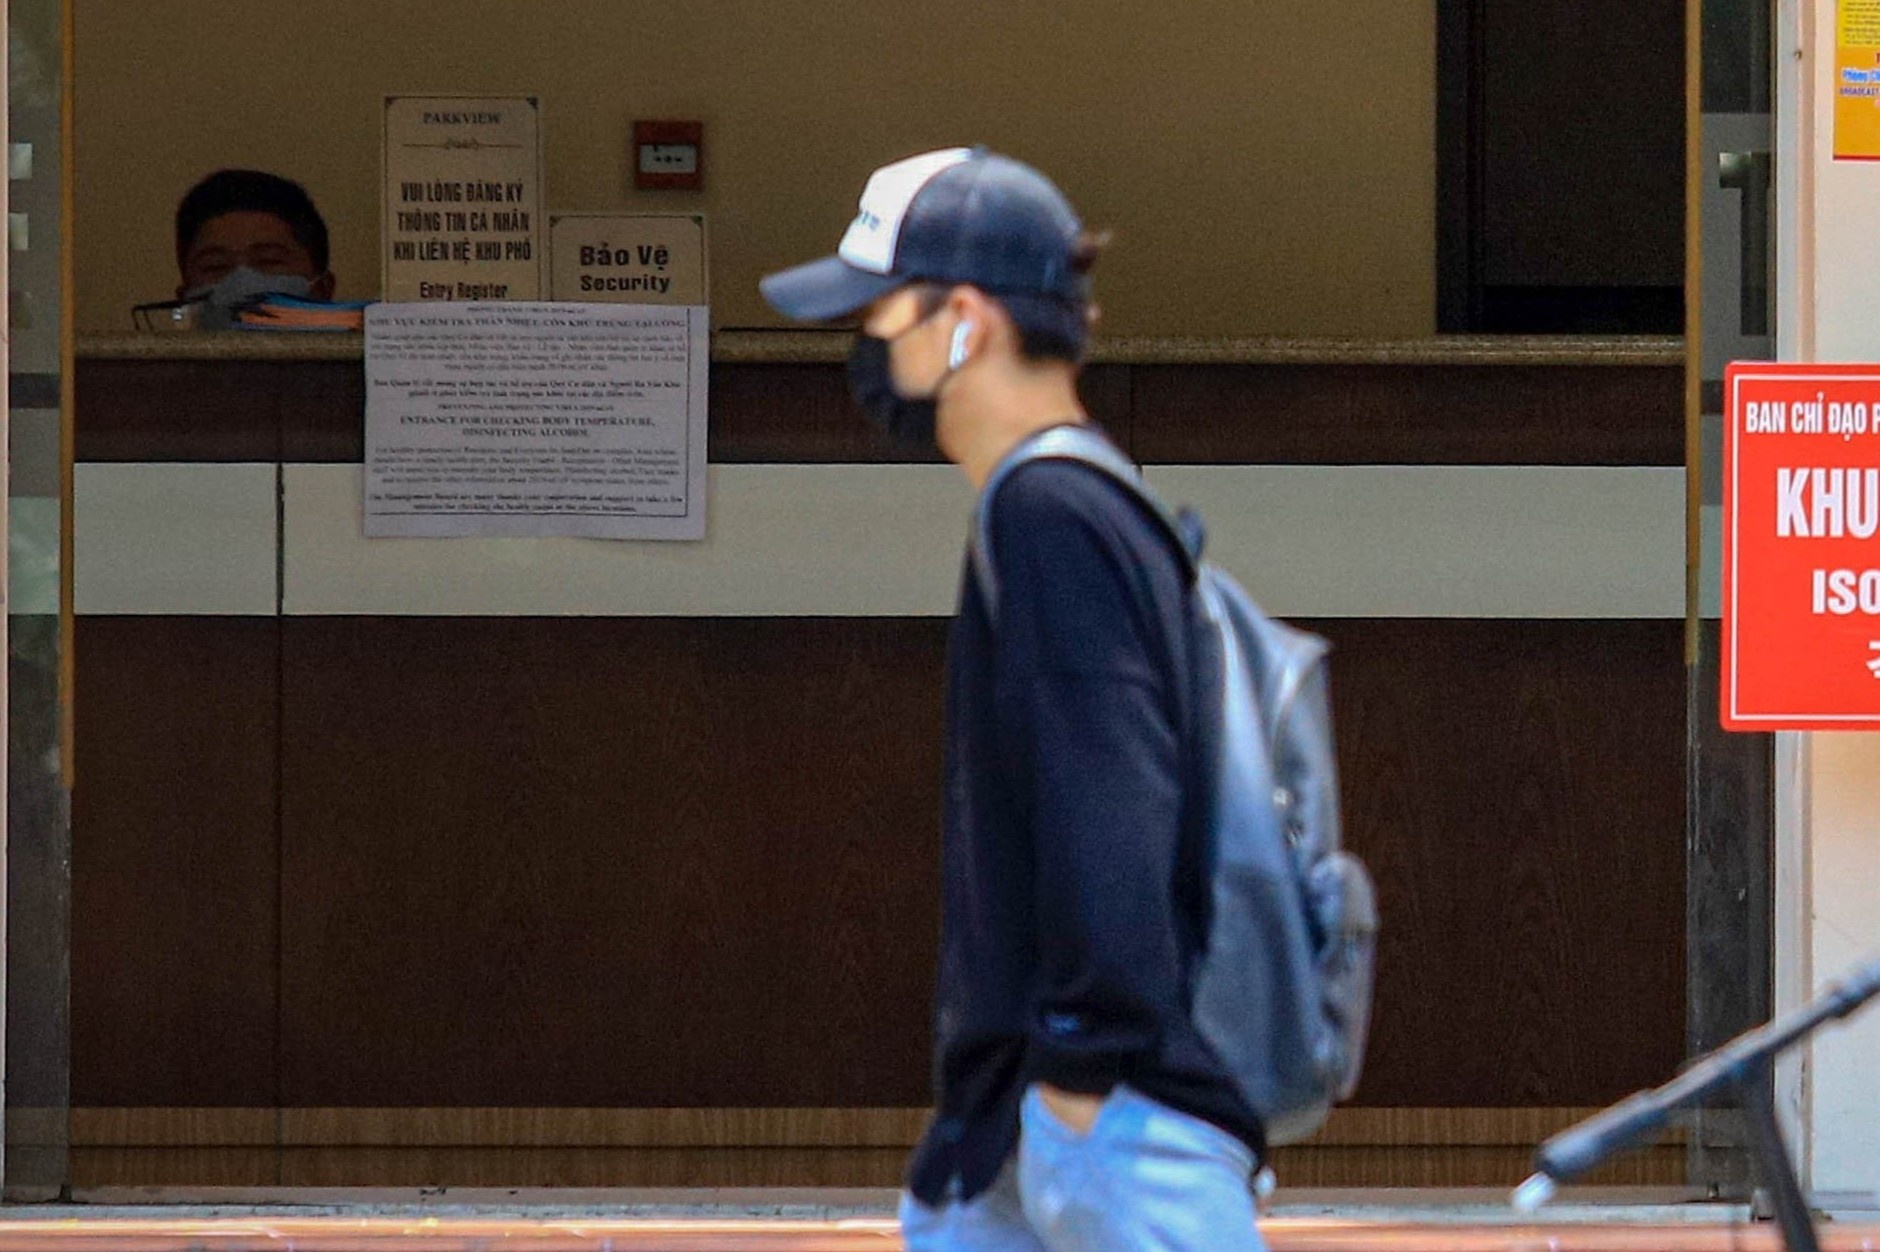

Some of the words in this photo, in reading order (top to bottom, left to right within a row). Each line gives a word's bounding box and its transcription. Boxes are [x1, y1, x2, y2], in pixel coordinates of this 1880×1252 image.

[423, 112, 501, 124] PARKVIEW
[401, 182, 423, 201] VUI
[427, 177, 462, 202] LÒNG
[506, 177, 524, 201] KÝ
[397, 207, 440, 232] THÔNG
[445, 212, 466, 231] TIN
[493, 208, 529, 232] NHÂN
[394, 241, 415, 260] KHI
[419, 237, 449, 260] LIÊN
[475, 241, 501, 260] KHU
[580, 241, 629, 266] Bảo
[637, 245, 669, 271] Vệ
[420, 282, 453, 300] Entry
[458, 282, 508, 300] Register
[580, 275, 670, 293] Security
[1745, 402, 1786, 433] BAN
[1791, 391, 1824, 434] CHỈ
[1828, 402, 1867, 441] ĐẠO
[1776, 467, 1879, 538] KHU
